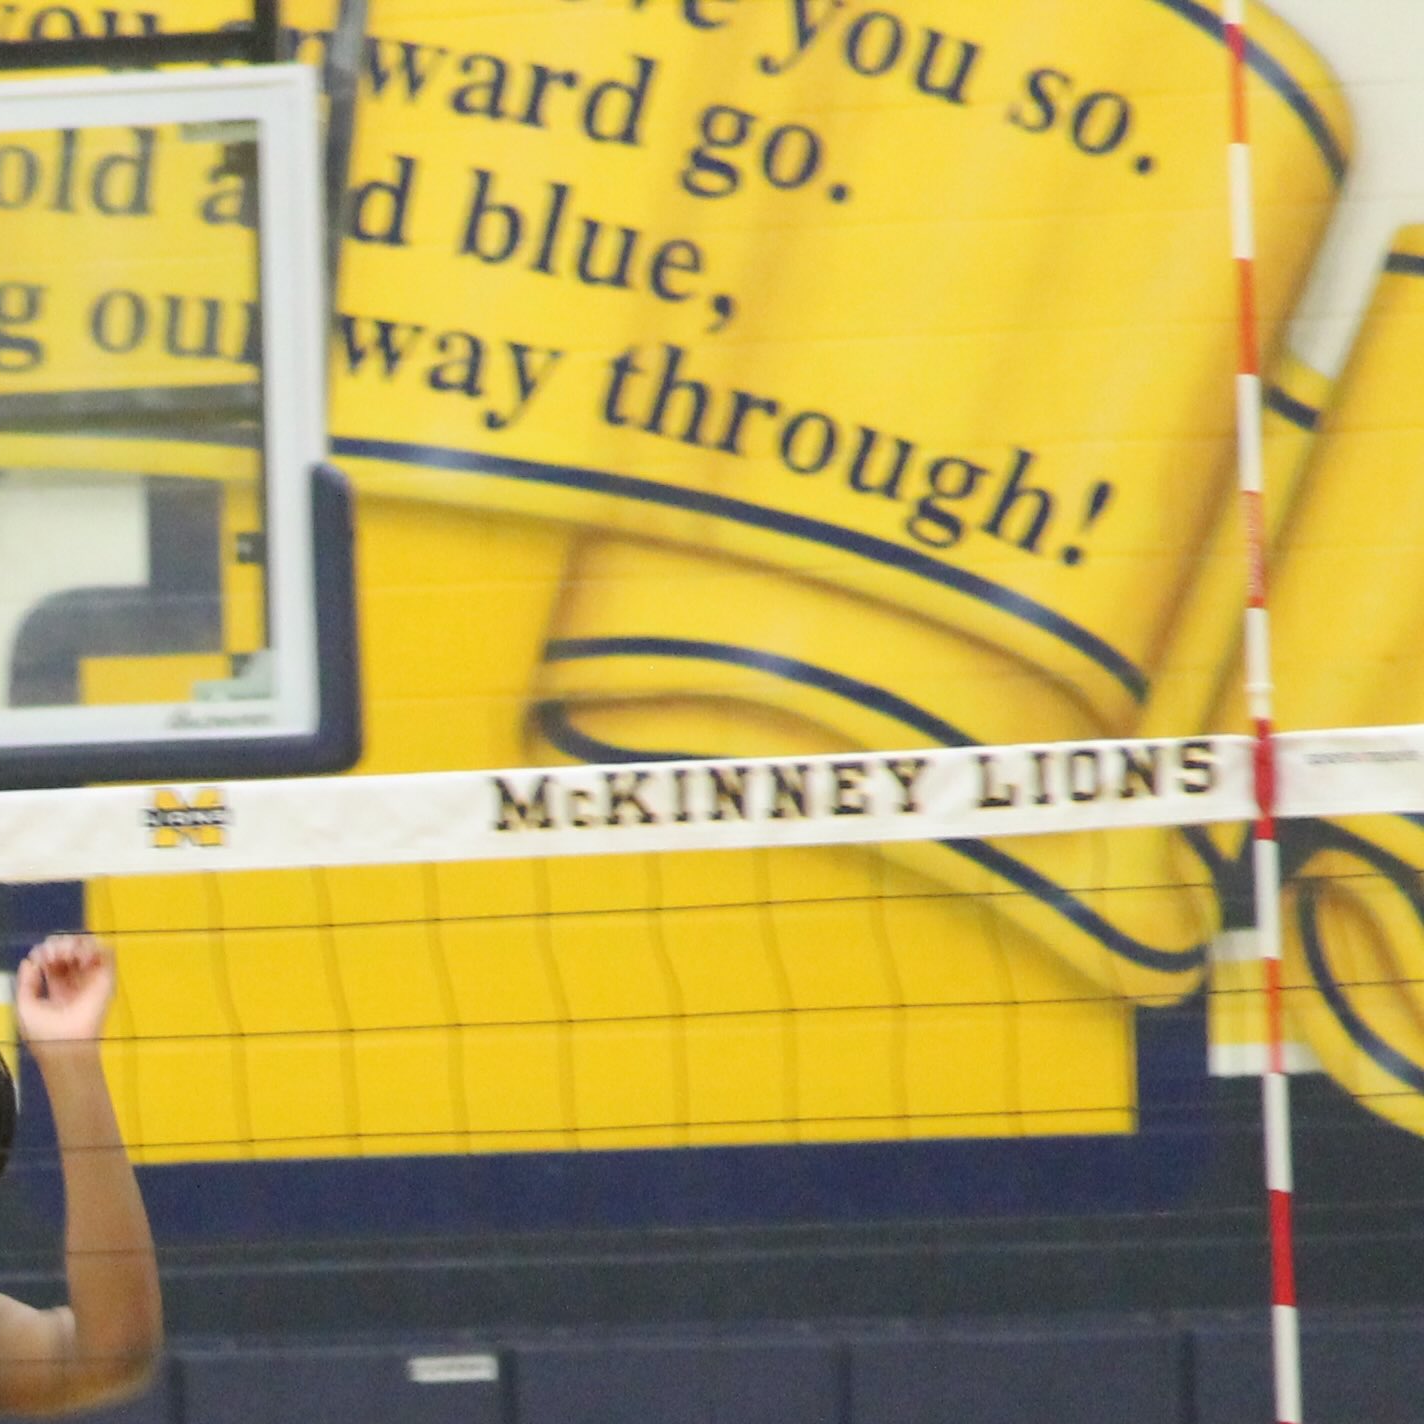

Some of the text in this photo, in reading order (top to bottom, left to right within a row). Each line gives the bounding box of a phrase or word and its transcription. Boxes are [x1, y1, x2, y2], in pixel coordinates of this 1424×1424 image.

[679, 104, 850, 204] go.
[757, 0, 1155, 176] you so.
[457, 165, 737, 334] blue,
[337, 313, 564, 431] way
[599, 343, 1118, 567] through!
[492, 739, 1219, 831] McKINNEY LIONS
